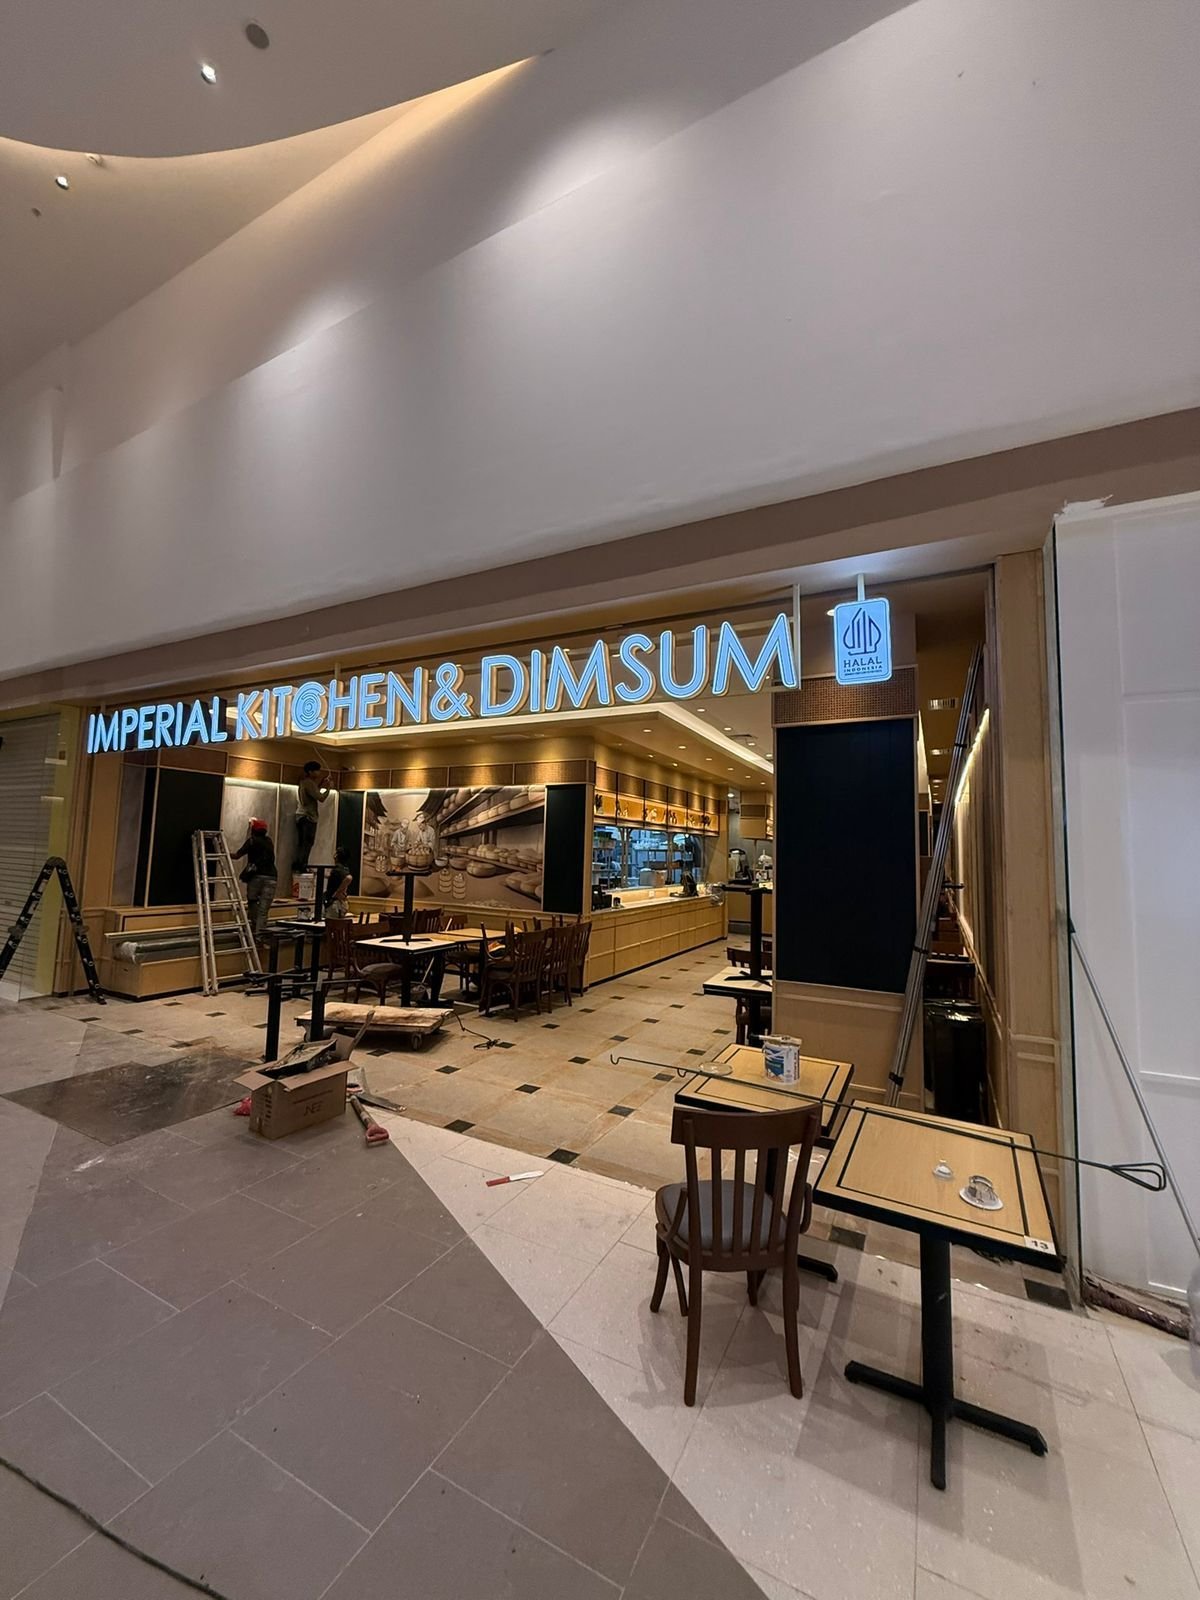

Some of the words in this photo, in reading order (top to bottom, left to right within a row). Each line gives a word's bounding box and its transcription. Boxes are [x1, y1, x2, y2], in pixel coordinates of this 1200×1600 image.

[843, 655, 882, 668] HALAL
[843, 664, 882, 673] INDONESIA
[87, 696, 227, 754] IMPERIAL
[235, 666, 428, 741] KITCHEN
[430, 662, 472, 722] &
[480, 612, 798, 717] DIMSUM
[1031, 1240, 1049, 1250] 13
